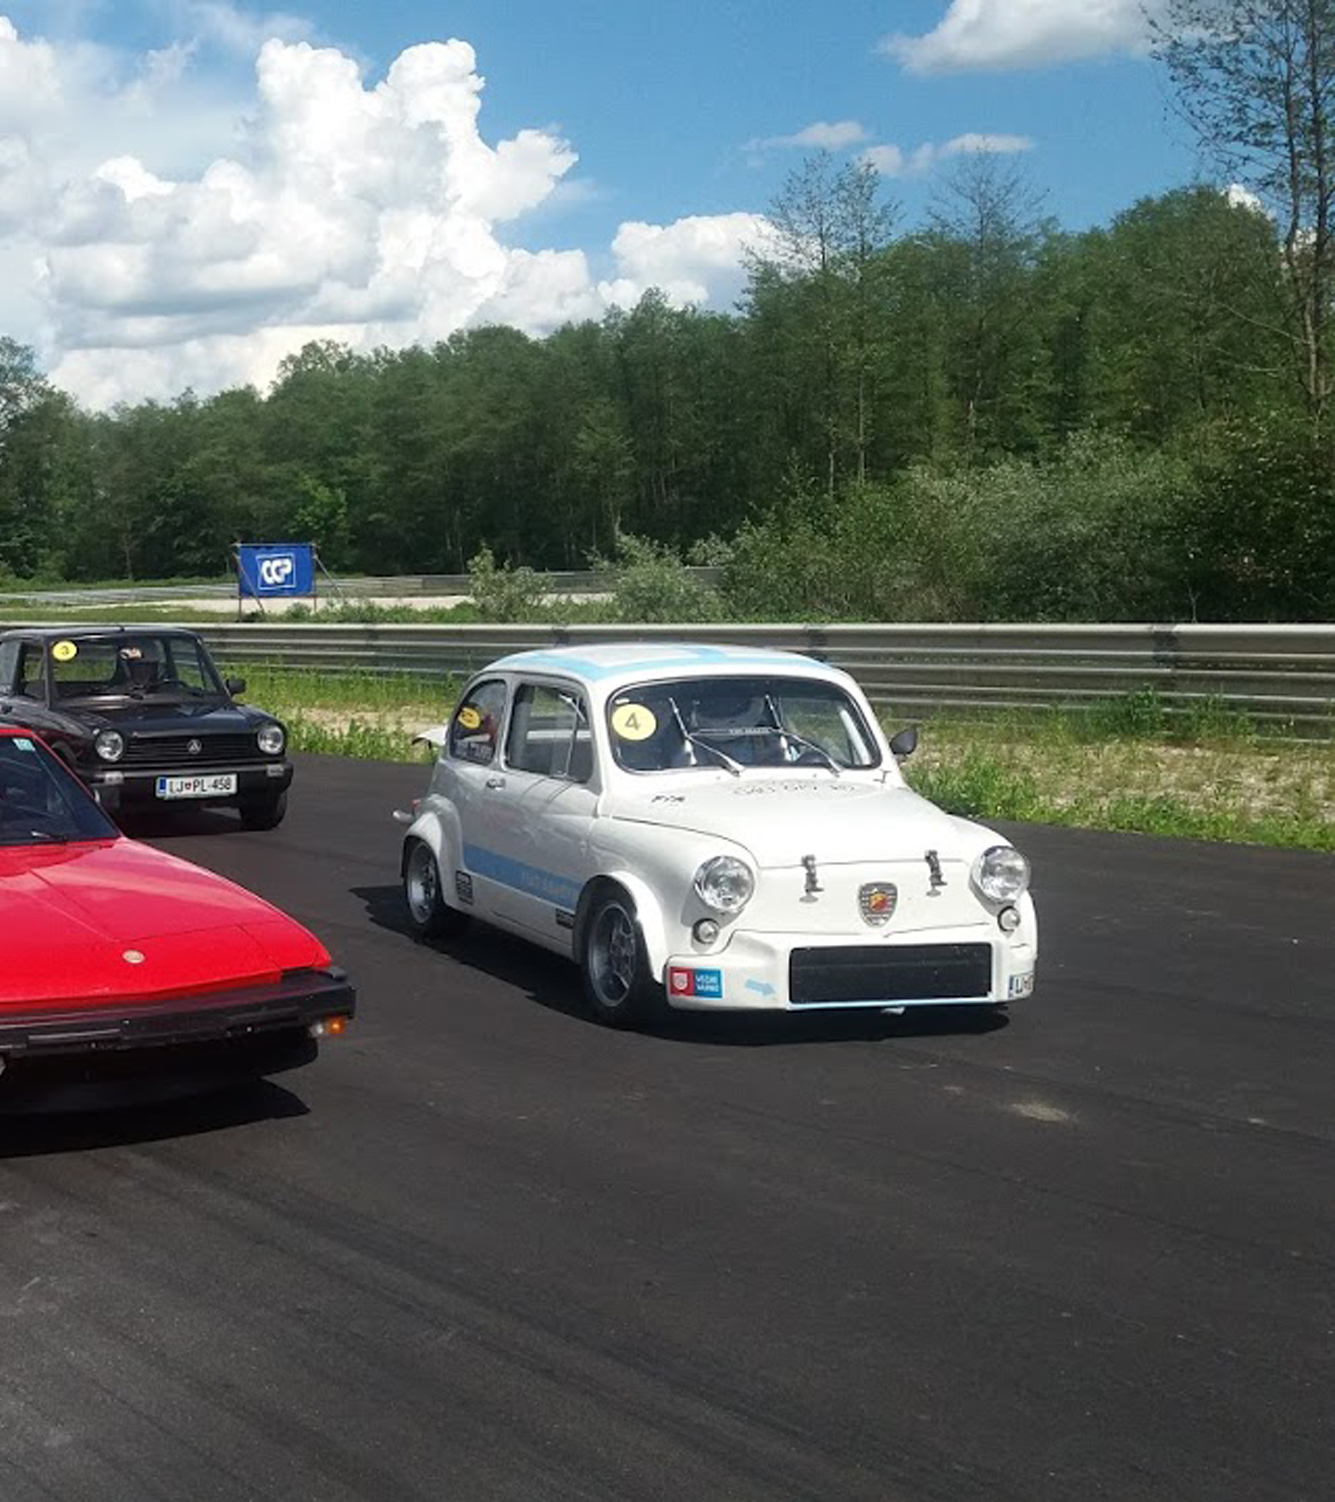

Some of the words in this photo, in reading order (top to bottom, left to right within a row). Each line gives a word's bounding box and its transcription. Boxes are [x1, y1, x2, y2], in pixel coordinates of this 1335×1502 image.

[625, 711, 642, 731] 4
[169, 780, 184, 793] LJ
[192, 776, 232, 792] PL-458
